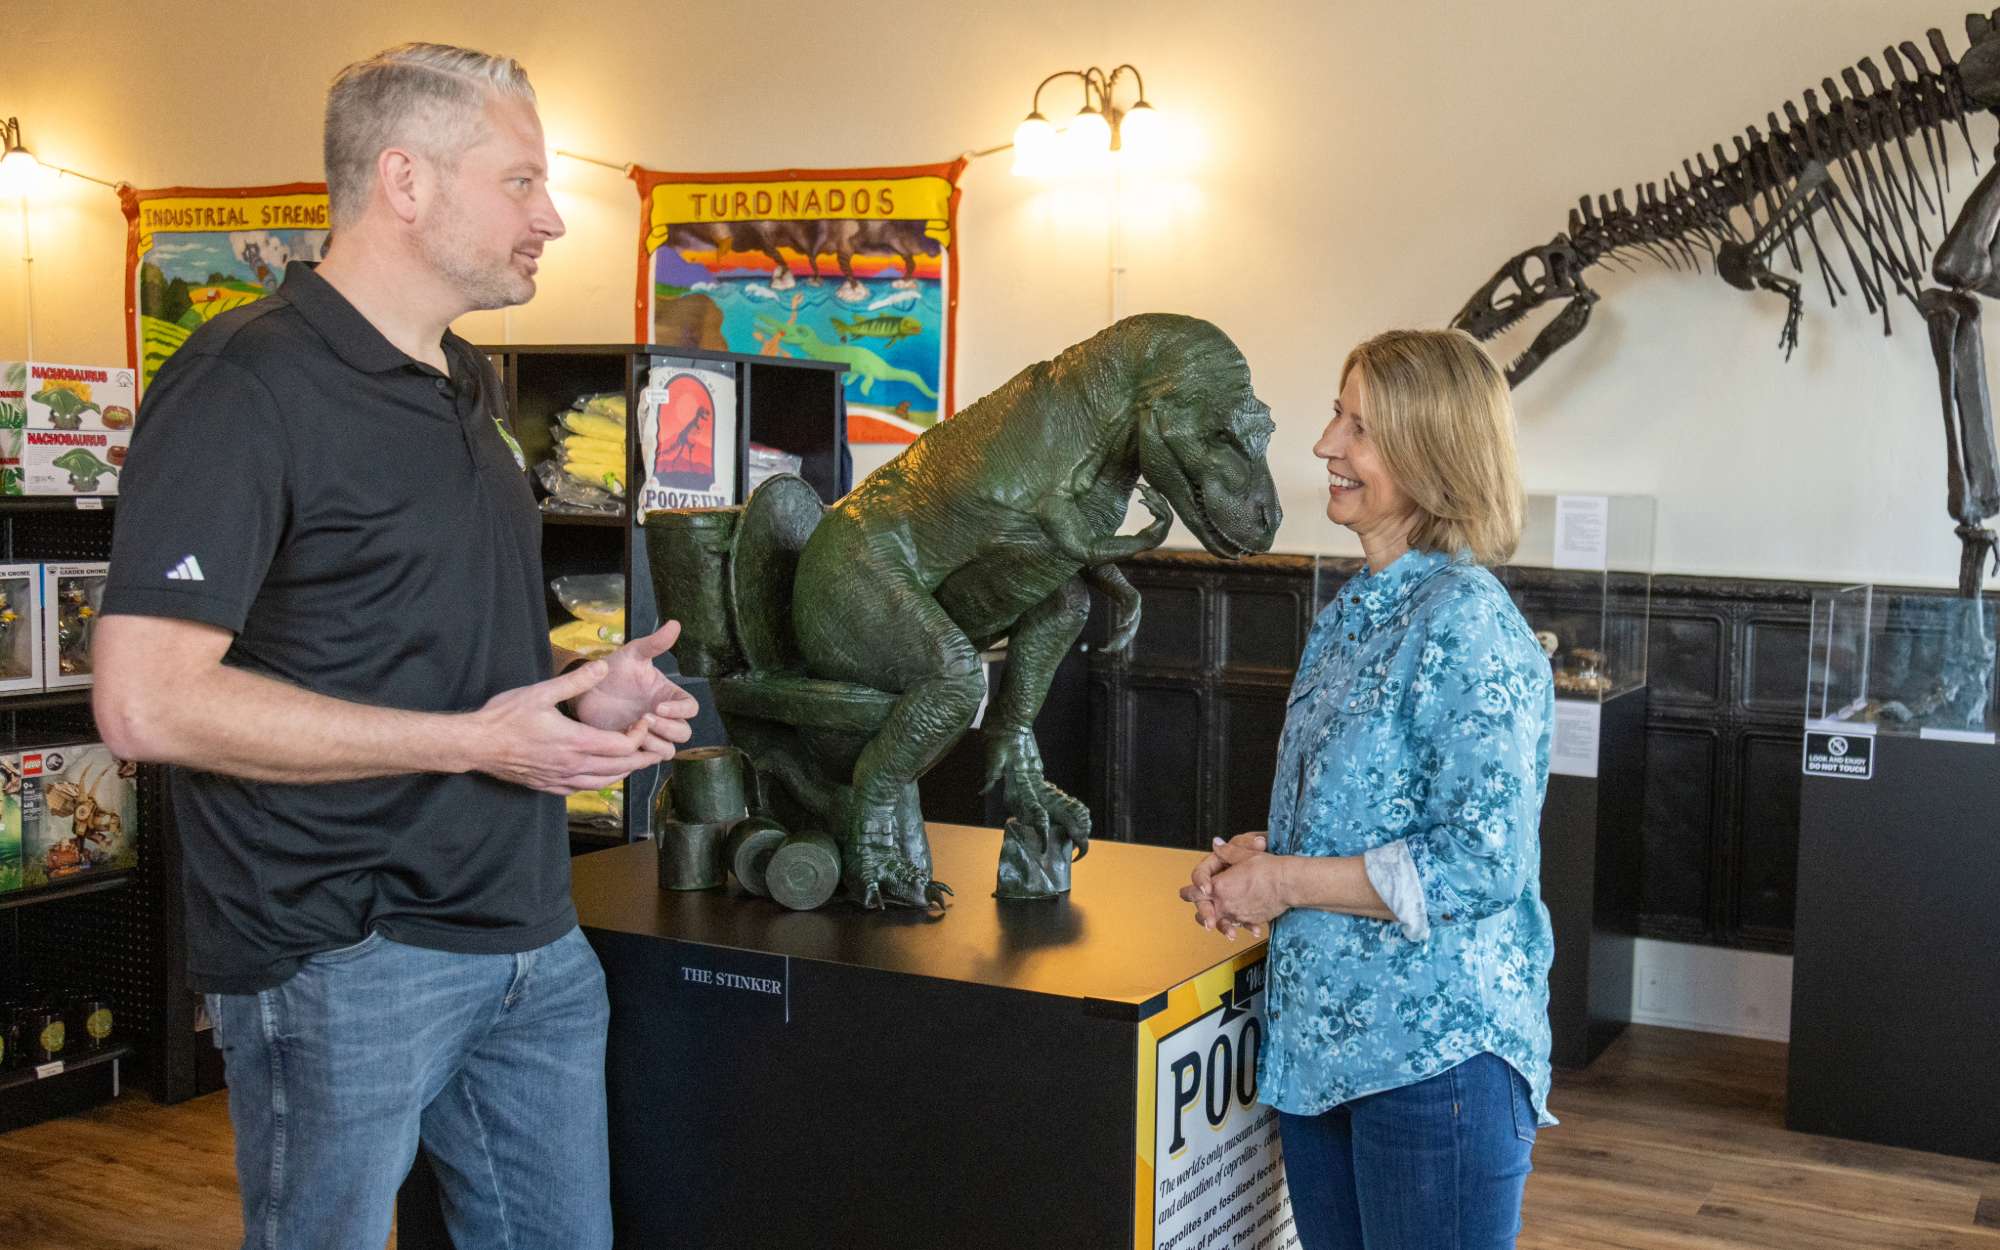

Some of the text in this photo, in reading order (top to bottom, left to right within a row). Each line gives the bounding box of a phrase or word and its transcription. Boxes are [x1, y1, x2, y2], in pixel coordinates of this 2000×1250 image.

[689, 187, 895, 218] TURDNADOS
[144, 207, 249, 227] INDUSTRIAL
[31, 366, 108, 383] NACHOSAURUS
[27, 433, 108, 447] NACHOSAURUS
[643, 489, 726, 509] POOZEUM
[24, 760, 41, 769] LEGO
[1808, 754, 1867, 765] LOOK AND ENJOY
[1808, 762, 1867, 774] DO NOT TOUCH
[681, 966, 782, 995] THE STINKER
[1160, 1178, 1176, 1198] The
[1176, 1154, 1206, 1190] world's
[1207, 1143, 1223, 1167] only
[1223, 1124, 1254, 1153] museum
[1158, 1199, 1176, 1225] and
[1176, 1175, 1214, 1211] education
[1214, 1163, 1224, 1187] of
[1223, 1143, 1258, 1177] coprolites
[1158, 1216, 1202, 1250] Coprolites
[1203, 1204, 1217, 1222] are
[1219, 1172, 1256, 1211] fossilized
[1256, 1159, 1277, 1182] feces
[1197, 1233, 1206, 1250] of
[1207, 1202, 1255, 1248] phosphates,
[1233, 1222, 1256, 1248] These
[1257, 1202, 1282, 1229] unique
